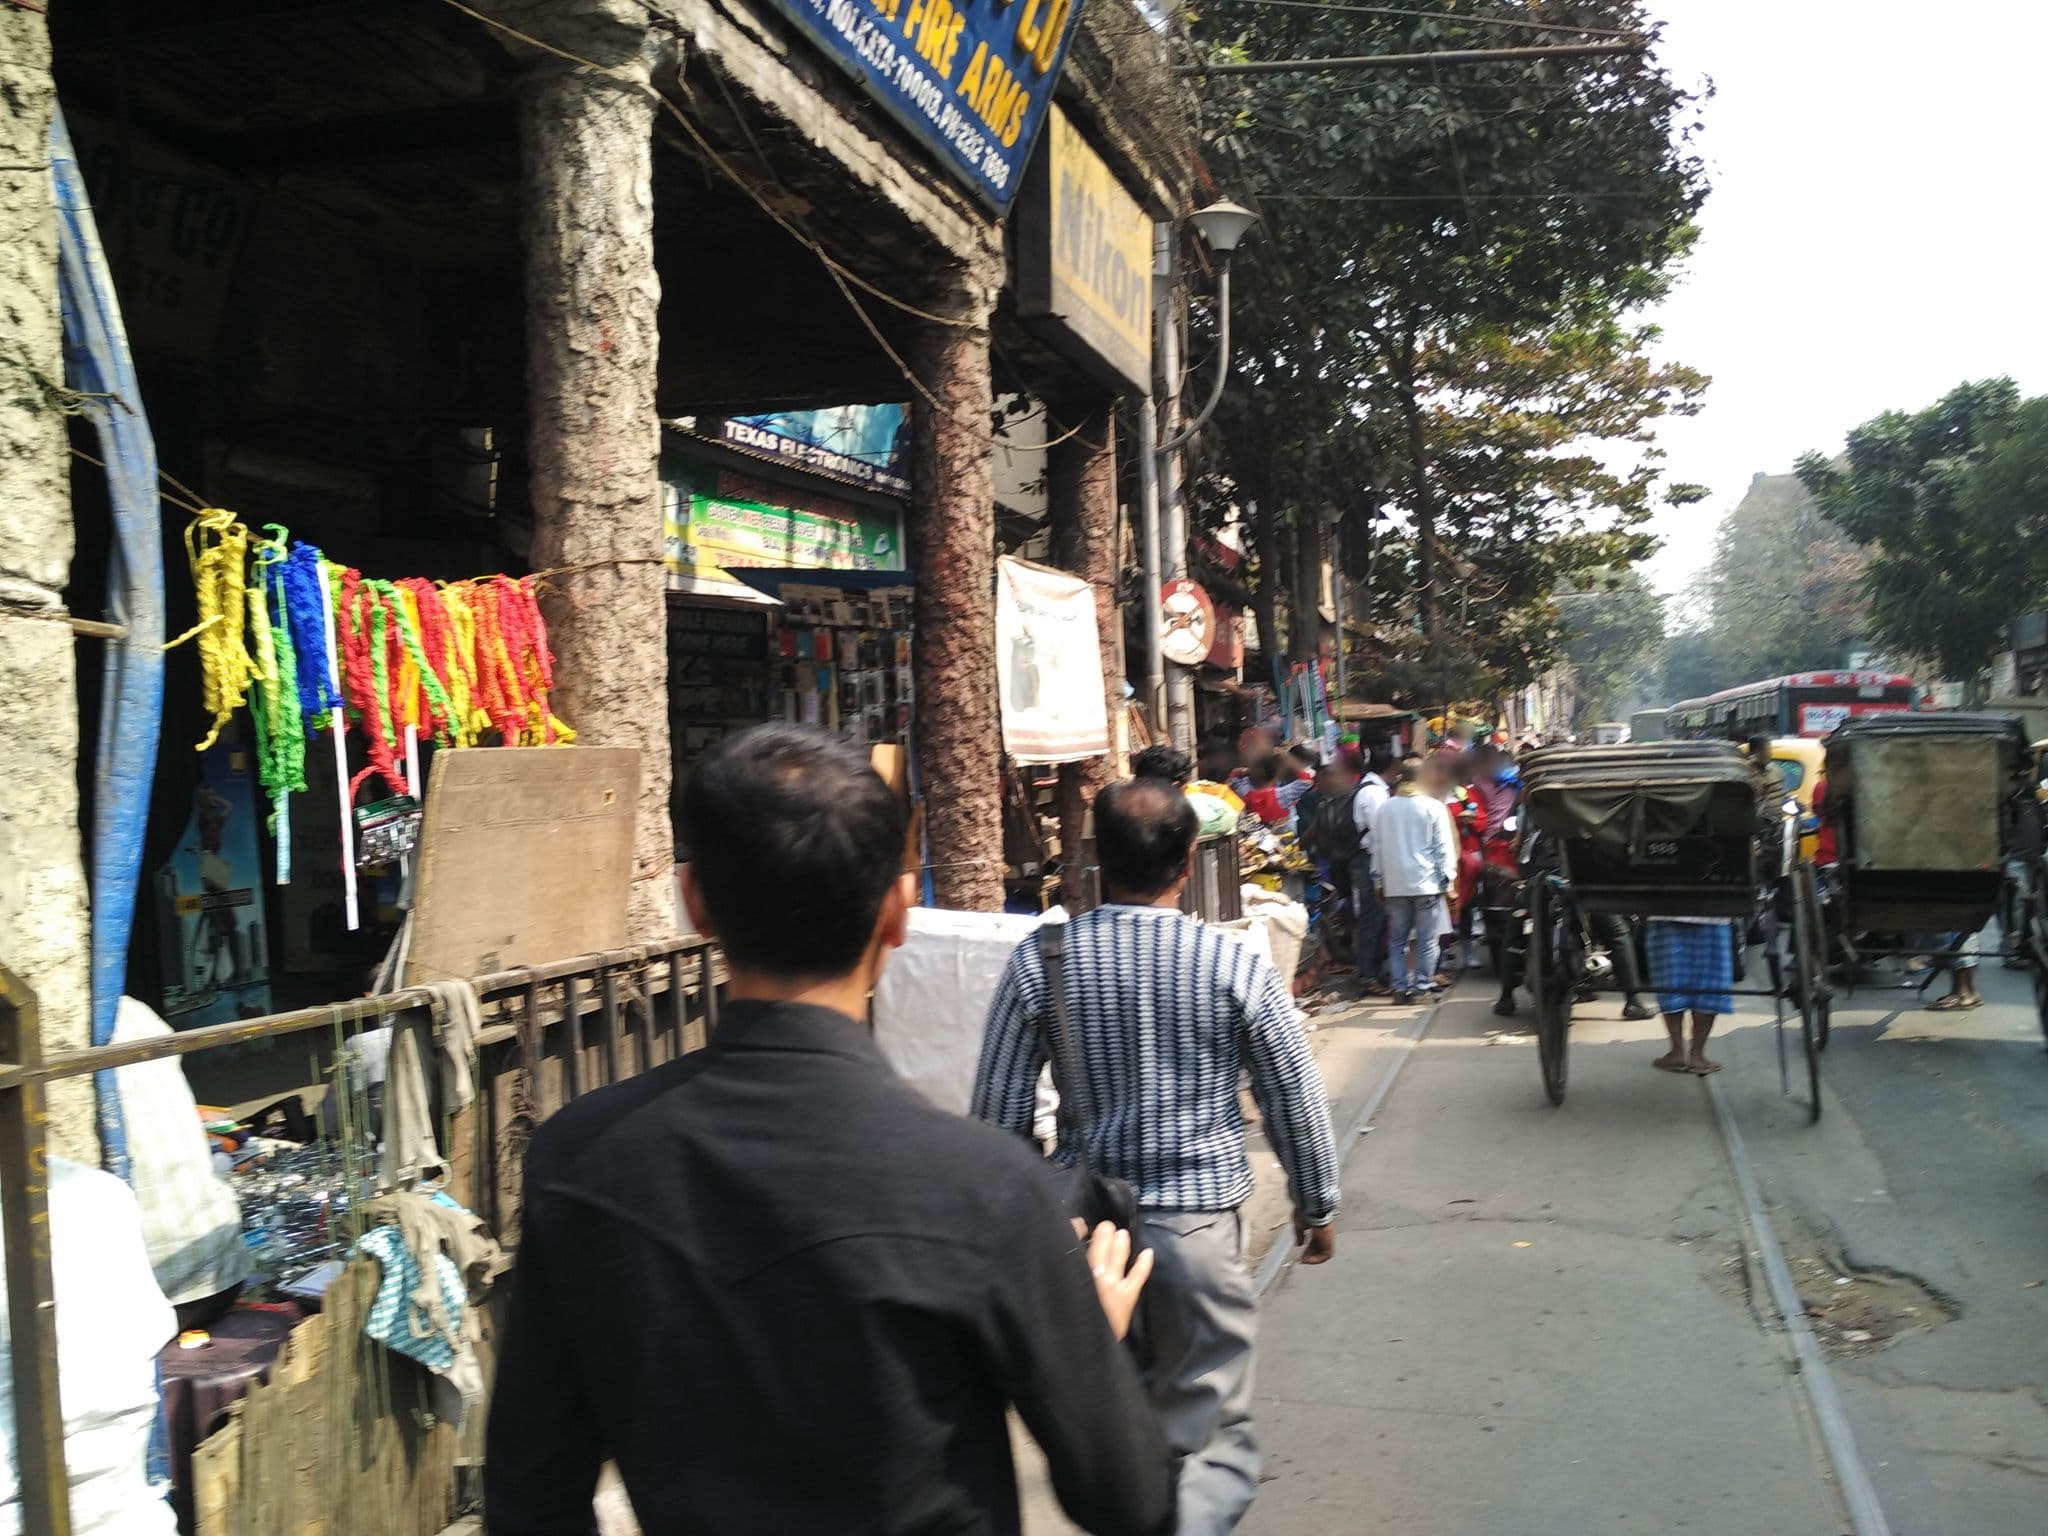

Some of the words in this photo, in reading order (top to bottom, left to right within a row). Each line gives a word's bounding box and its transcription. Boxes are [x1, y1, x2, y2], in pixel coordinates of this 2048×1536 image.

[903, 0, 966, 80] FIRE
[955, 40, 1031, 149] ARMS
[1057, 170, 1146, 336] Nikon
[725, 420, 778, 452] TEXAS
[779, 439, 873, 480] ELECTRONICS
